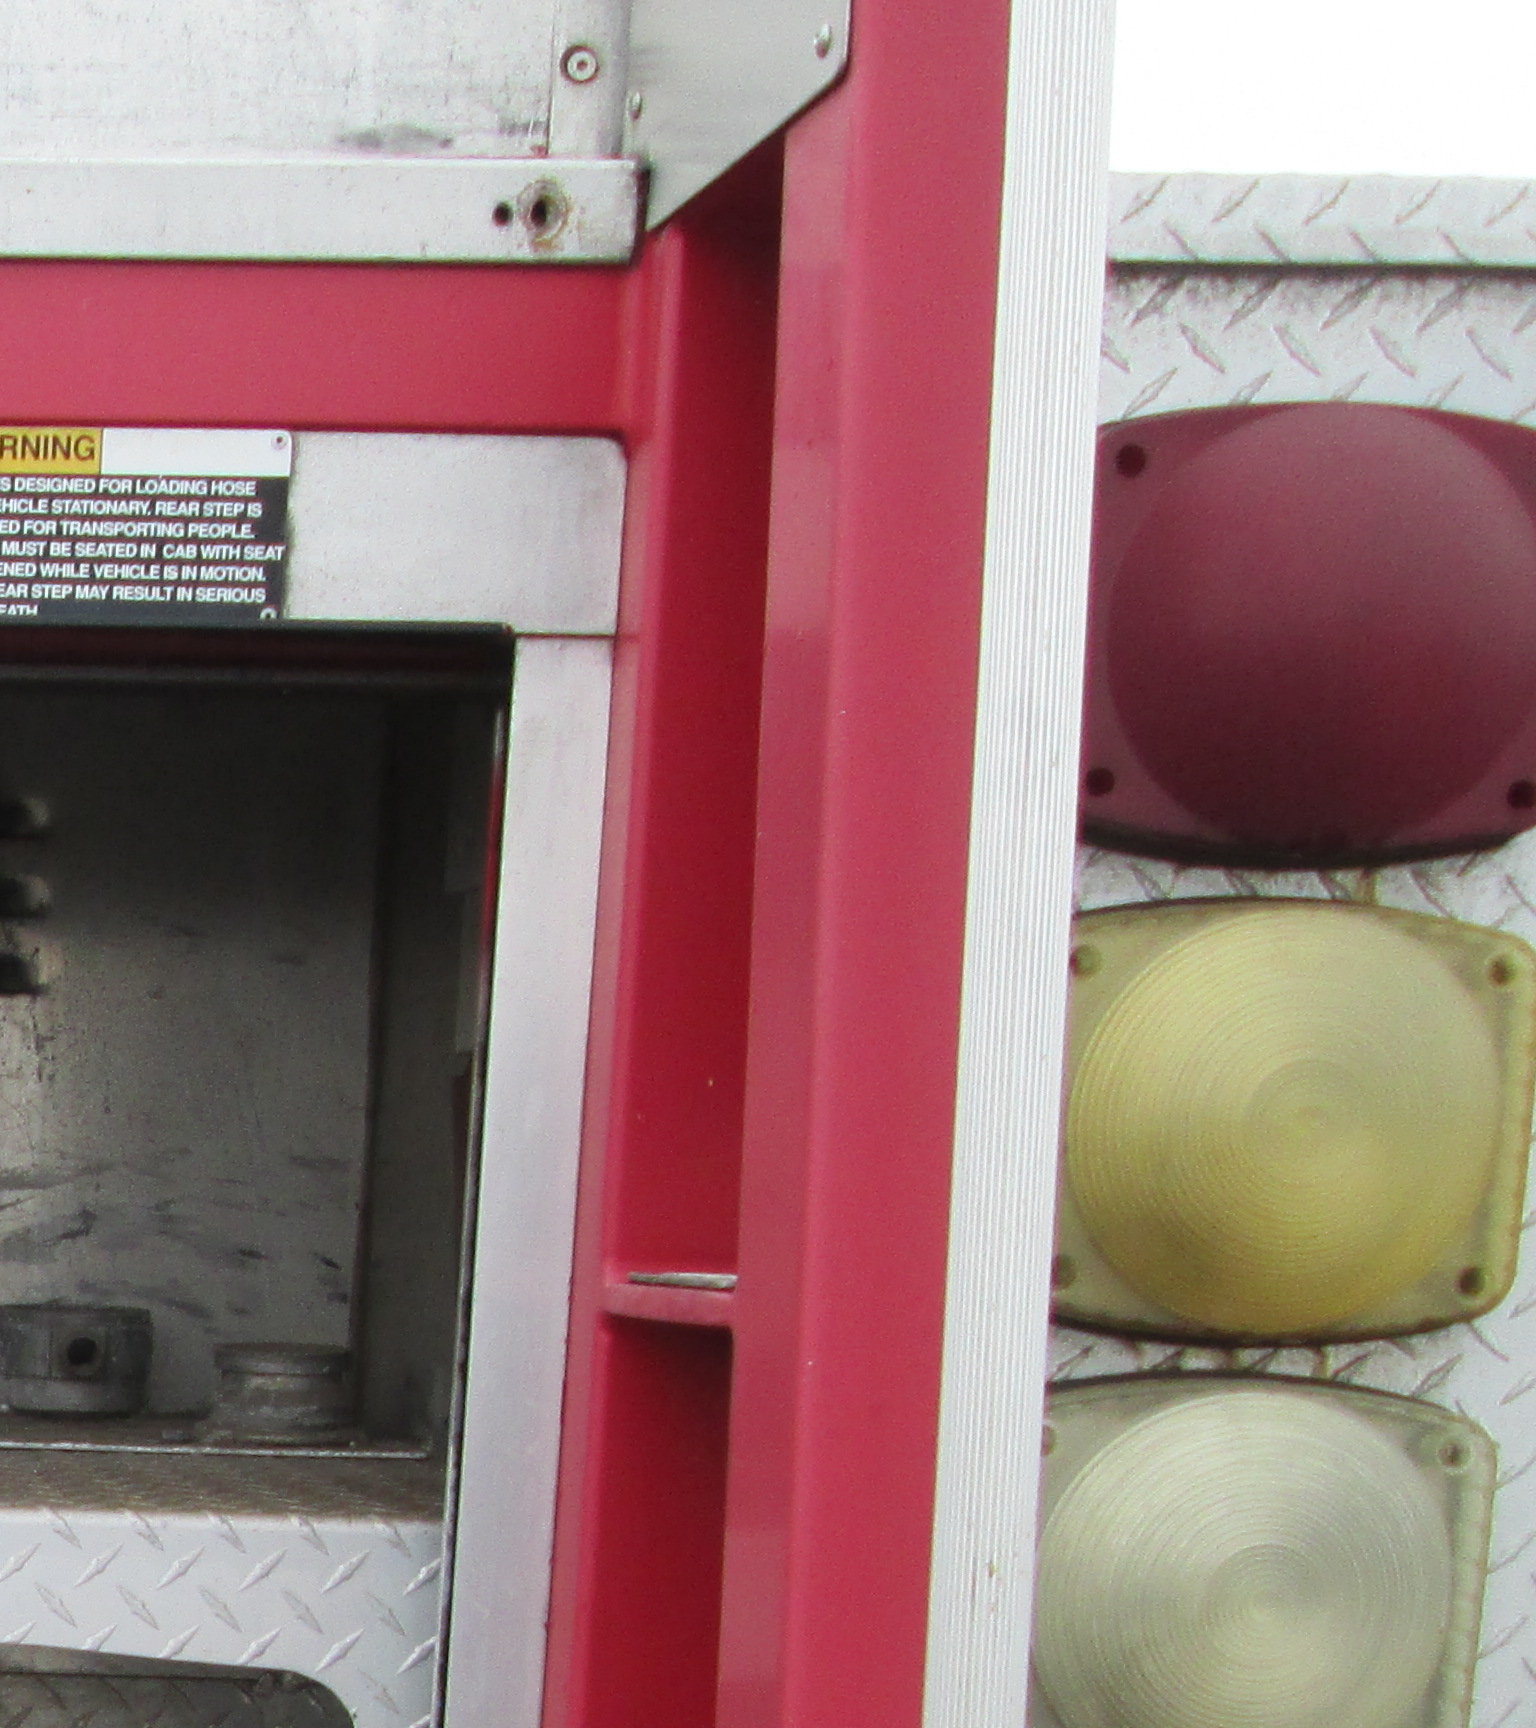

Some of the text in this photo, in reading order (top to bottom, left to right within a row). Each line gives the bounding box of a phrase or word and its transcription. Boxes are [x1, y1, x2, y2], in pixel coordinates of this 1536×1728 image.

[15, 477, 96, 492] DESIGNED
[99, 479, 132, 494] FOR
[136, 479, 207, 495] LOADING
[211, 480, 257, 496] HOSE
[52, 499, 151, 516] STATIONARY.
[156, 501, 200, 516] REAR
[203, 502, 245, 517] STEP
[247, 503, 262, 517] IS
[24, 520, 57, 535] FOR
[59, 521, 184, 538] TRANSPORTING
[188, 523, 255, 538] PEOPLE.
[2, 541, 47, 556] MUST
[50, 542, 71, 557] BE
[75, 542, 137, 558] SEATED
[140, 544, 156, 558] IN
[163, 544, 197, 559] CAB
[200, 545, 240, 560] WITH
[243, 545, 286, 561] SEAT
[40, 563, 90, 578] WHILE
[94, 564, 160, 579] VEHICLE
[163, 565, 178, 580] IS
[182, 566, 197, 580] IN
[200, 566, 266, 581] MOTION.
[31, 584, 72, 599] STEP
[76, 585, 110, 600] MAY
[112, 586, 174, 601] RESULT
[177, 587, 192, 601] IN
[195, 587, 266, 602] SERIOUS
